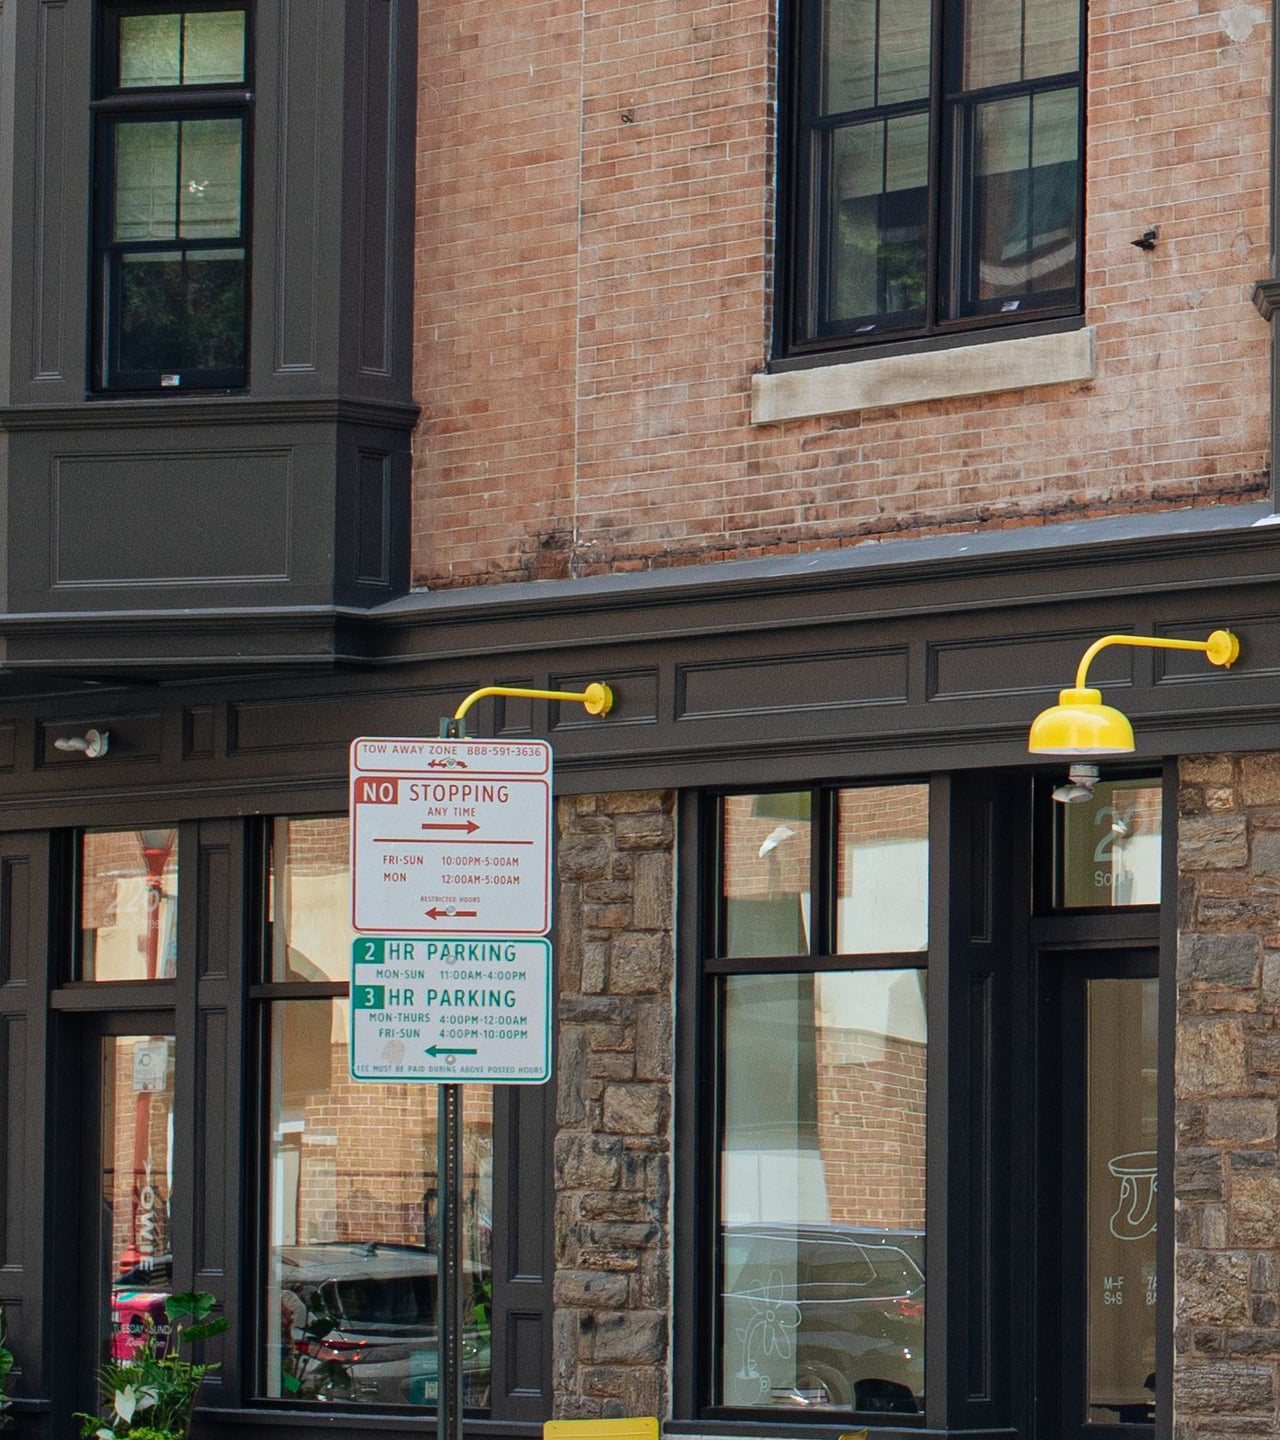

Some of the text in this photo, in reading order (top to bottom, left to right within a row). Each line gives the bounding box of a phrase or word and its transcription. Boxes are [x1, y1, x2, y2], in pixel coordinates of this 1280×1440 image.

[362, 744, 542, 757] TOW AWAY ZONE 888-591-3636
[363, 782, 509, 803] NO STOPPING
[427, 807, 476, 817] ANY TIME
[383, 855, 519, 867] FRI-SUN 10:00PM-5:00AM
[383, 872, 520, 885] MON 12:00AM-5:00AM
[364, 942, 517, 962] 2 HR PARKING
[376, 969, 527, 981] MON-SUN 11:00AM-4:00PM
[364, 988, 517, 1008] 3 HR PARKING
[369, 1013, 528, 1025] MON-THURS 4:00PM-12:00AM
[378, 1028, 528, 1039] FRI-SUN 4:00PM-10:00PM
[372, 1065, 392, 1073] MUST
[395, 1065, 404, 1073] BE
[407, 1065, 425, 1073] PAID
[487, 1066, 515, 1074] POSTED
[139, 1160, 155, 1272] YOWIE
[1103, 1291, 1123, 1305] S+S
[112, 1323, 144, 1333] TUESDAY
[149, 1324, 172, 1335] SUND
